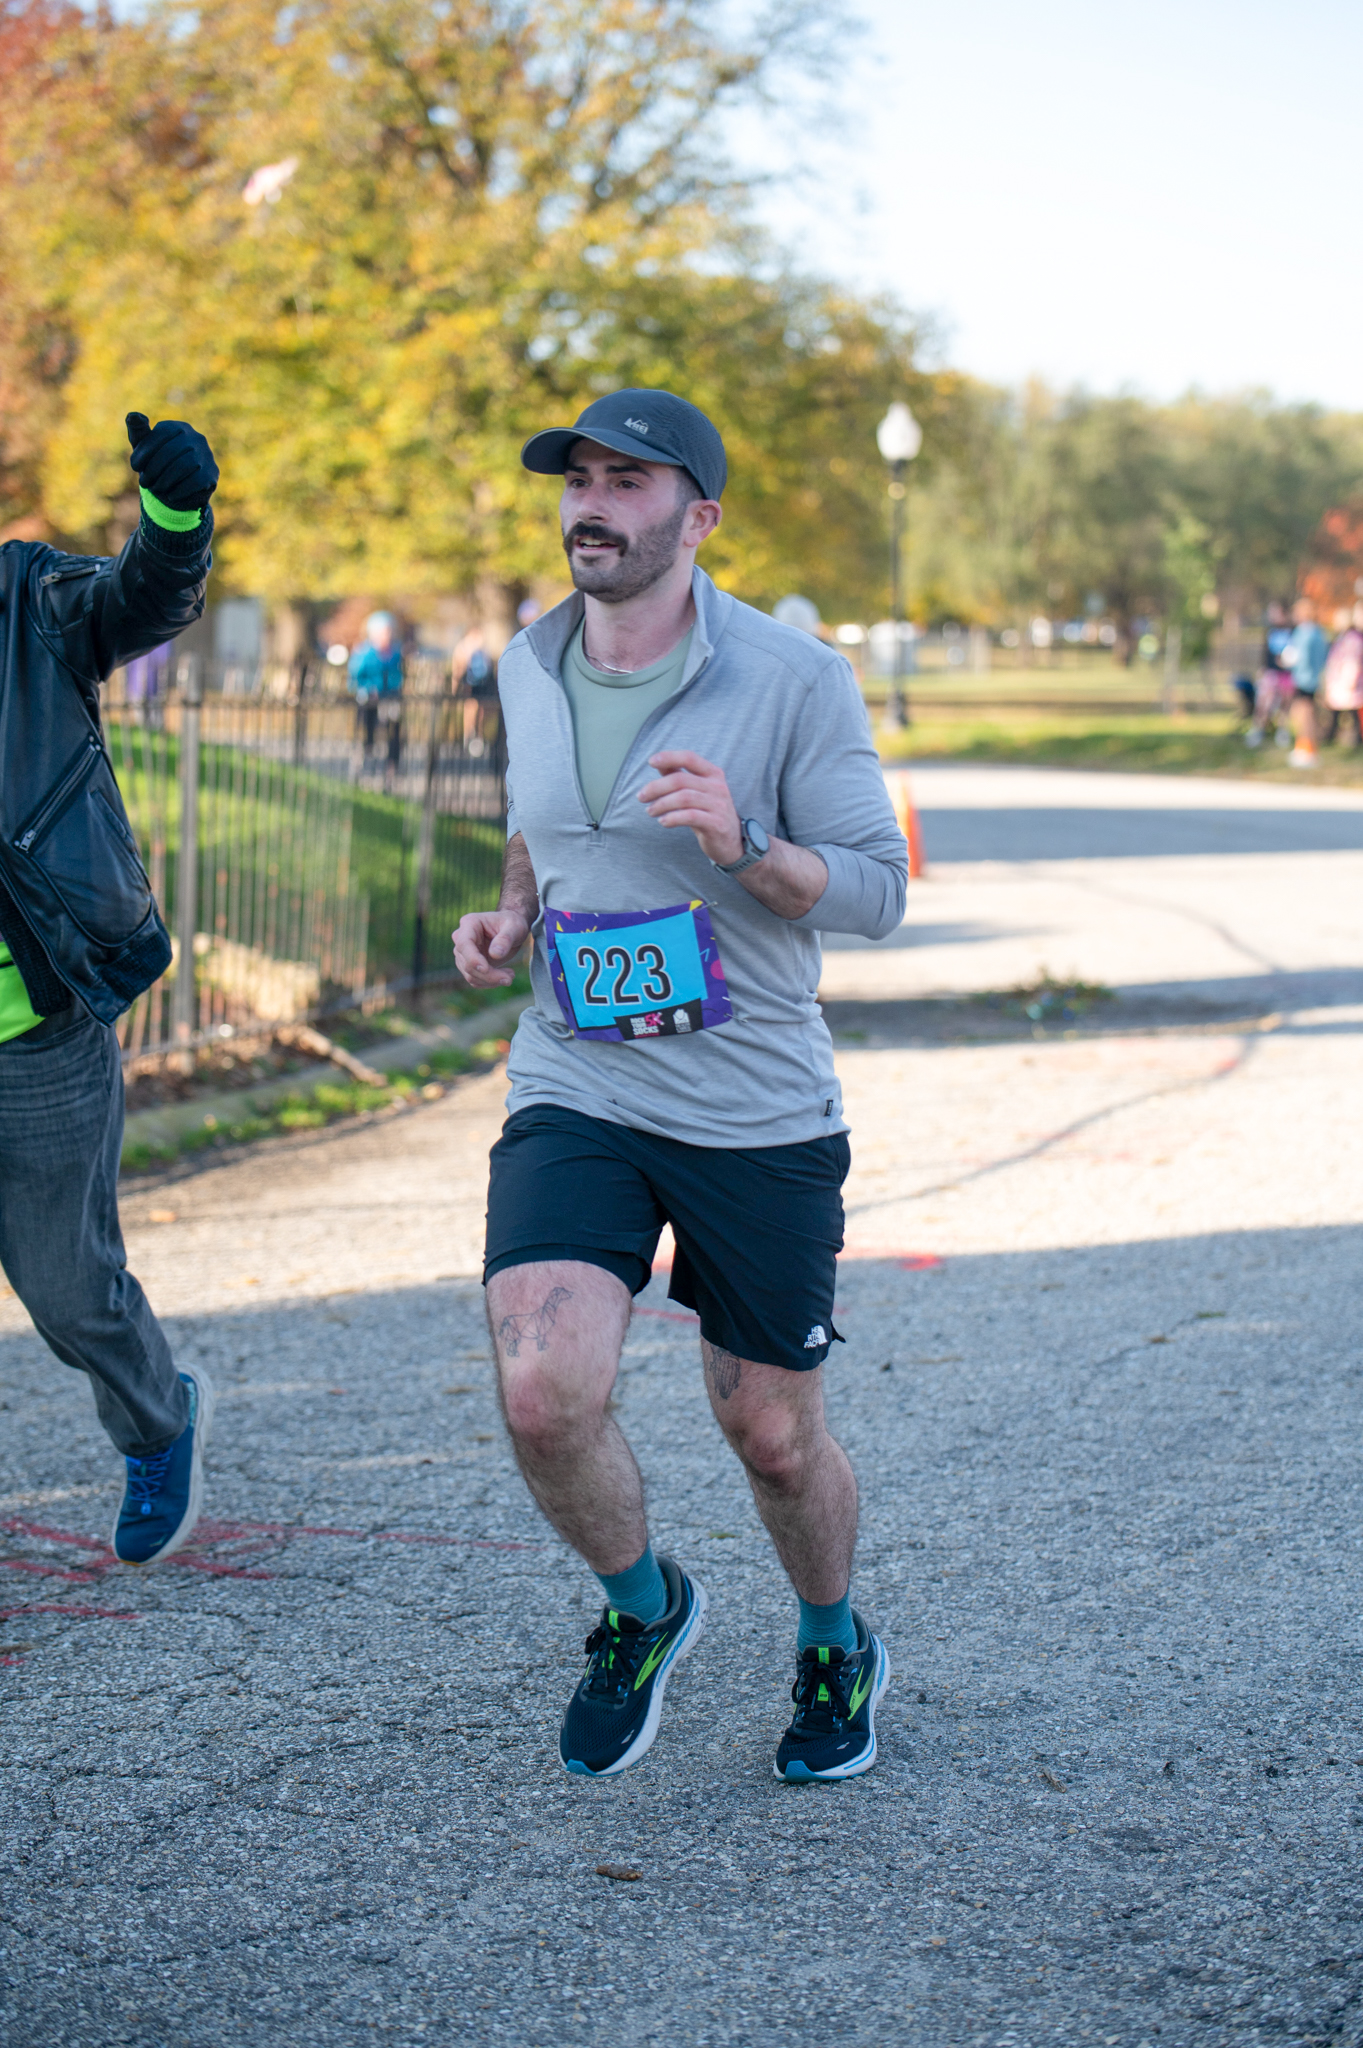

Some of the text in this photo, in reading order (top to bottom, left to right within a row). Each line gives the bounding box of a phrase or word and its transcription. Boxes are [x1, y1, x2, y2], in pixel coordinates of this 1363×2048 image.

[577, 944, 672, 1006] 223
[645, 1012, 665, 1027] 5K
[633, 1025, 659, 1036] SOCKS
